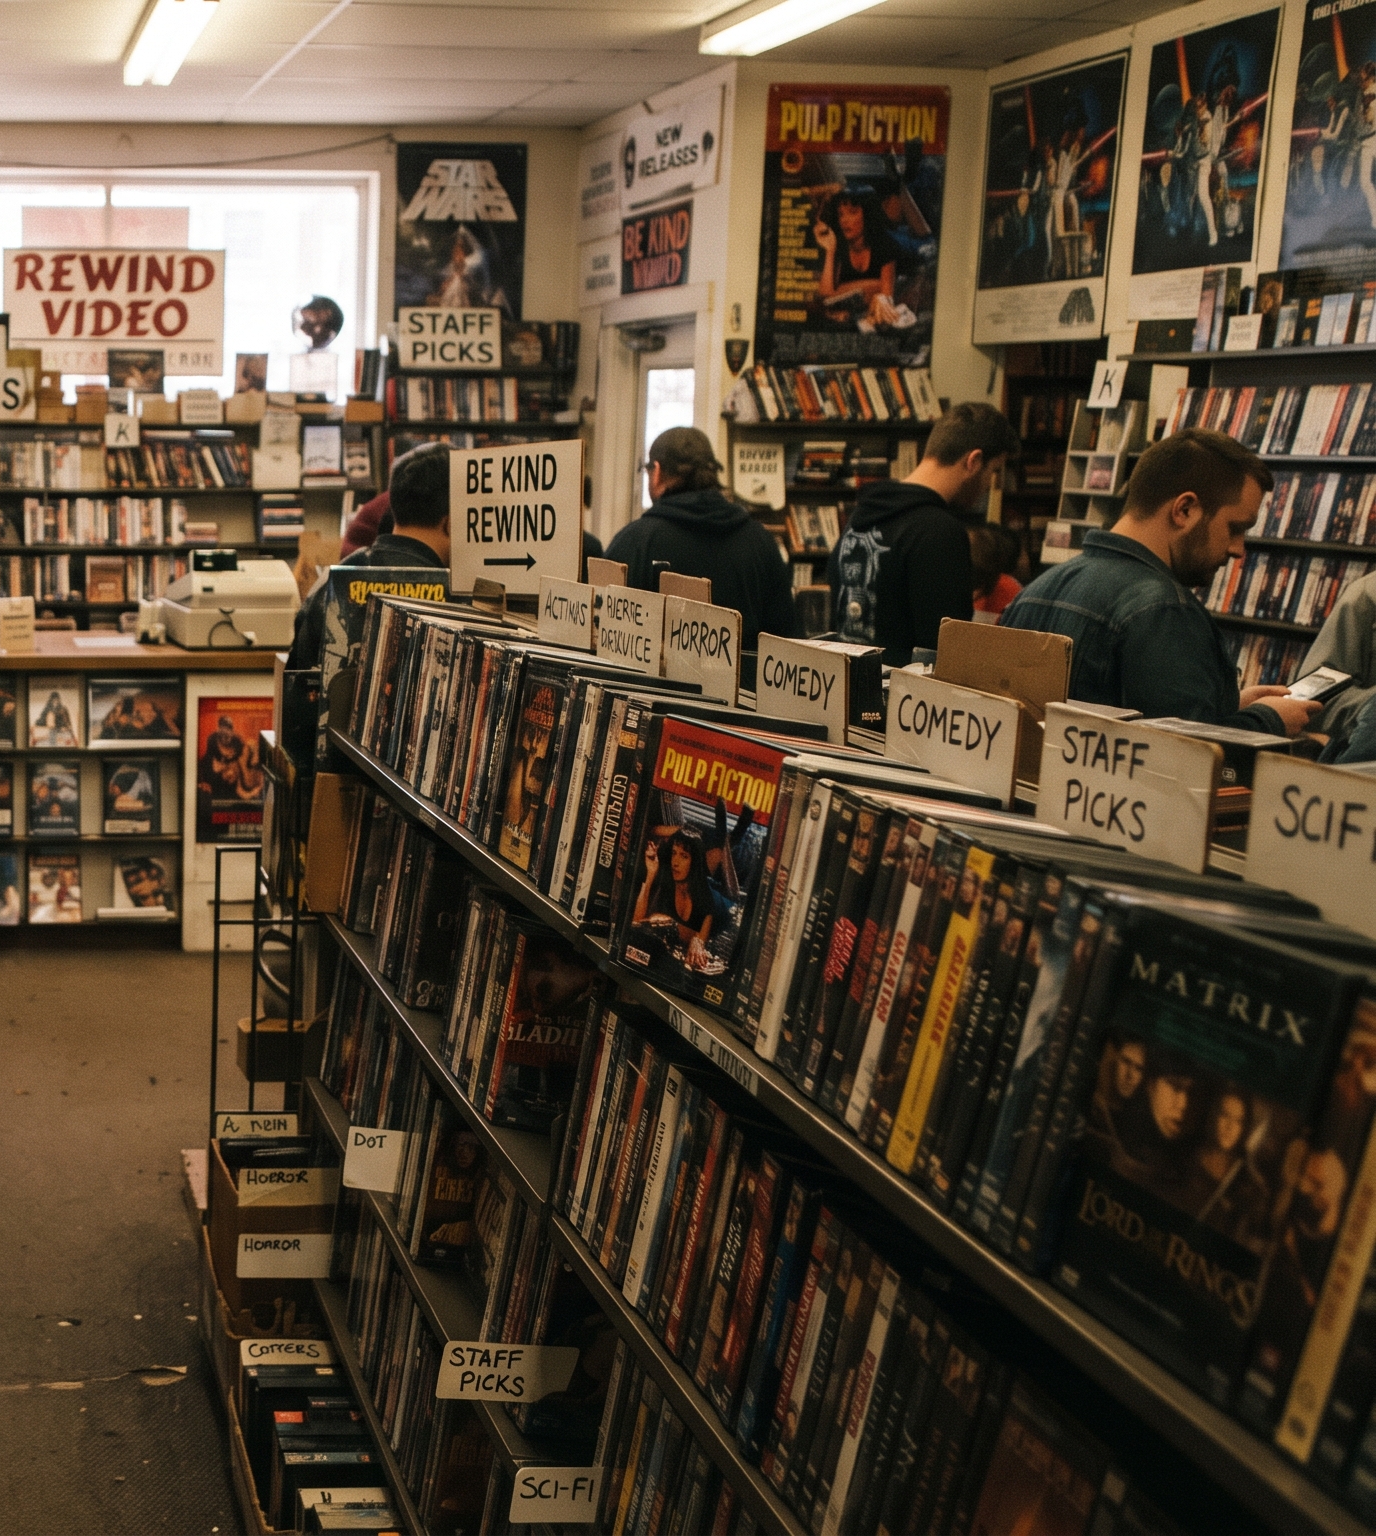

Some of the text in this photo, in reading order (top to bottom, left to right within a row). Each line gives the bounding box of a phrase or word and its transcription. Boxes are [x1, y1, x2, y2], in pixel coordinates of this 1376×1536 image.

[656, 122, 683, 148] NEW
[779, 101, 938, 143] PULP FICTION
[624, 209, 691, 262] BE KIND
[12, 251, 216, 294] REWIND
[41, 298, 190, 338] VIDEO
[408, 312, 494, 336] STAFF
[411, 340, 494, 365] PICKS
[466, 453, 557, 495] BE KIND
[466, 503, 557, 544] REWIND
[669, 618, 732, 667] HORROR
[763, 654, 836, 711] COMEDY
[898, 693, 1002, 760] COMEDY
[1062, 725, 1150, 779] STAFF
[660, 747, 777, 815] PULP FICTION
[1065, 779, 1148, 843] PICKS
[1129, 952, 1311, 1047] MATRIX
[354, 1133, 387, 1149] DOT
[449, 1347, 524, 1369] STAFF
[460, 1371, 525, 1397] PICKS
[520, 1477, 594, 1502] SCI-FI
